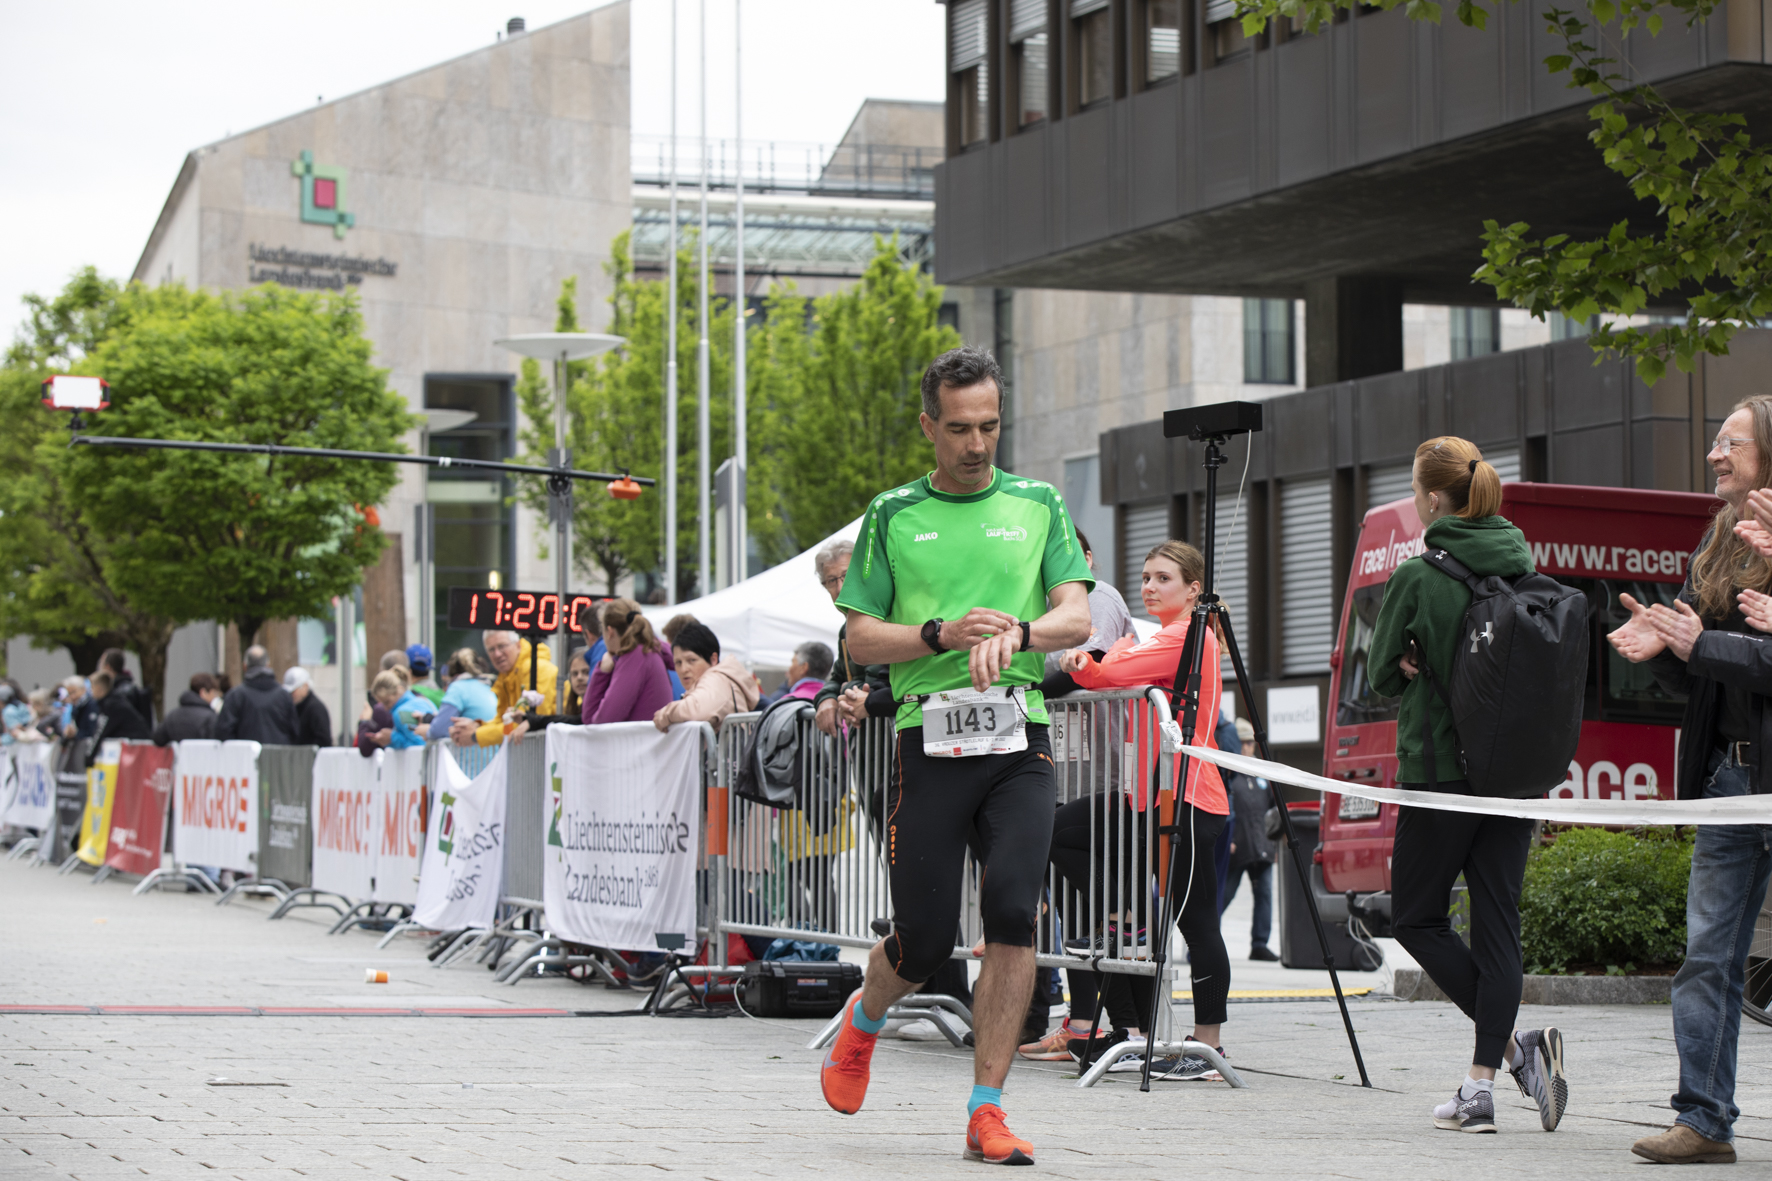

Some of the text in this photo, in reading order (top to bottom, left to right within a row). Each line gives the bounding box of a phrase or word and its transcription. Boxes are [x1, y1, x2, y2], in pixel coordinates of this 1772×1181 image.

[914, 531, 938, 542] JAKO
[1527, 541, 1692, 576] www.racer
[469, 593, 592, 632] 17:20:0
[944, 706, 997, 736] 1143
[381, 789, 418, 858] MIG
[566, 810, 690, 854] Liechtensteinische
[565, 863, 644, 909] Landesbank
